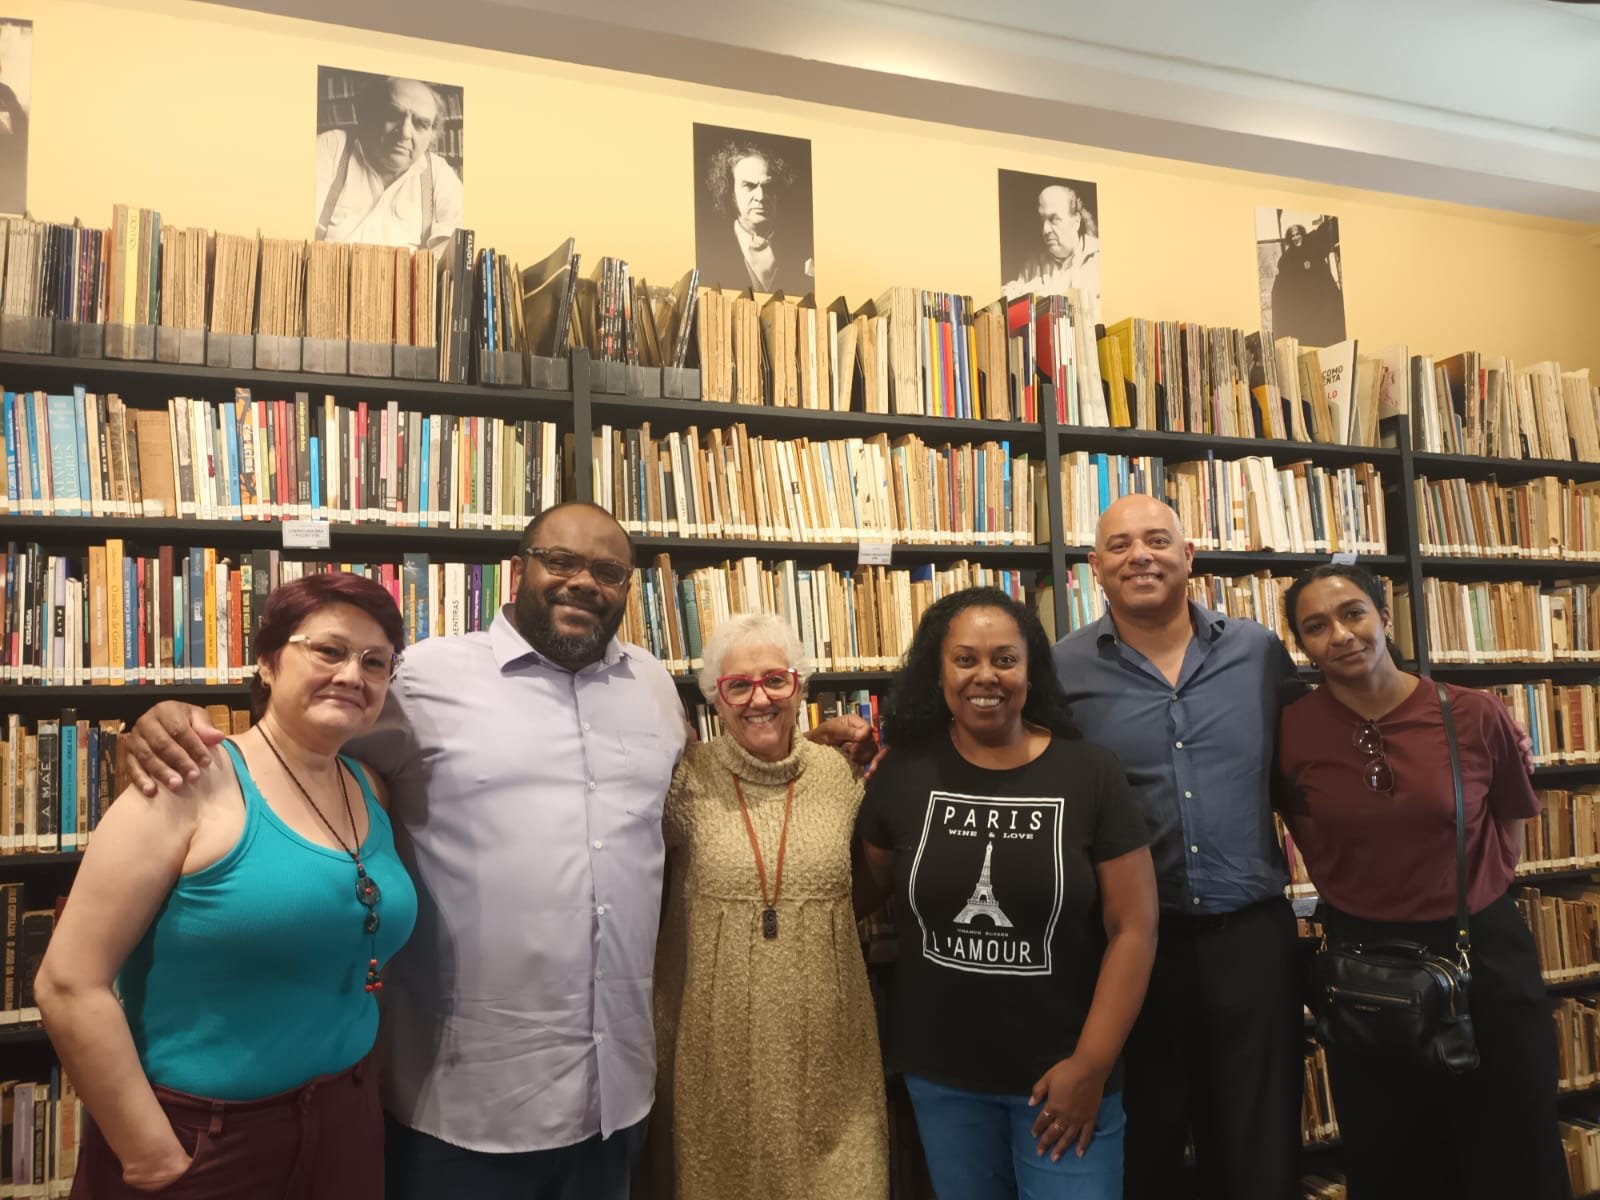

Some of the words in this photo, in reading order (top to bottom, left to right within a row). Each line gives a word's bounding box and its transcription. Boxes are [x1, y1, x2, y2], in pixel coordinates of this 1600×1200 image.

[1321, 365, 1343, 379] COMO
[1324, 374, 1341, 385] NTA
[39, 762, 51, 798] MÃE
[943, 806, 1043, 830] PARIS
[948, 829, 977, 837] WINE
[932, 930, 1032, 963] L'AMOUR
